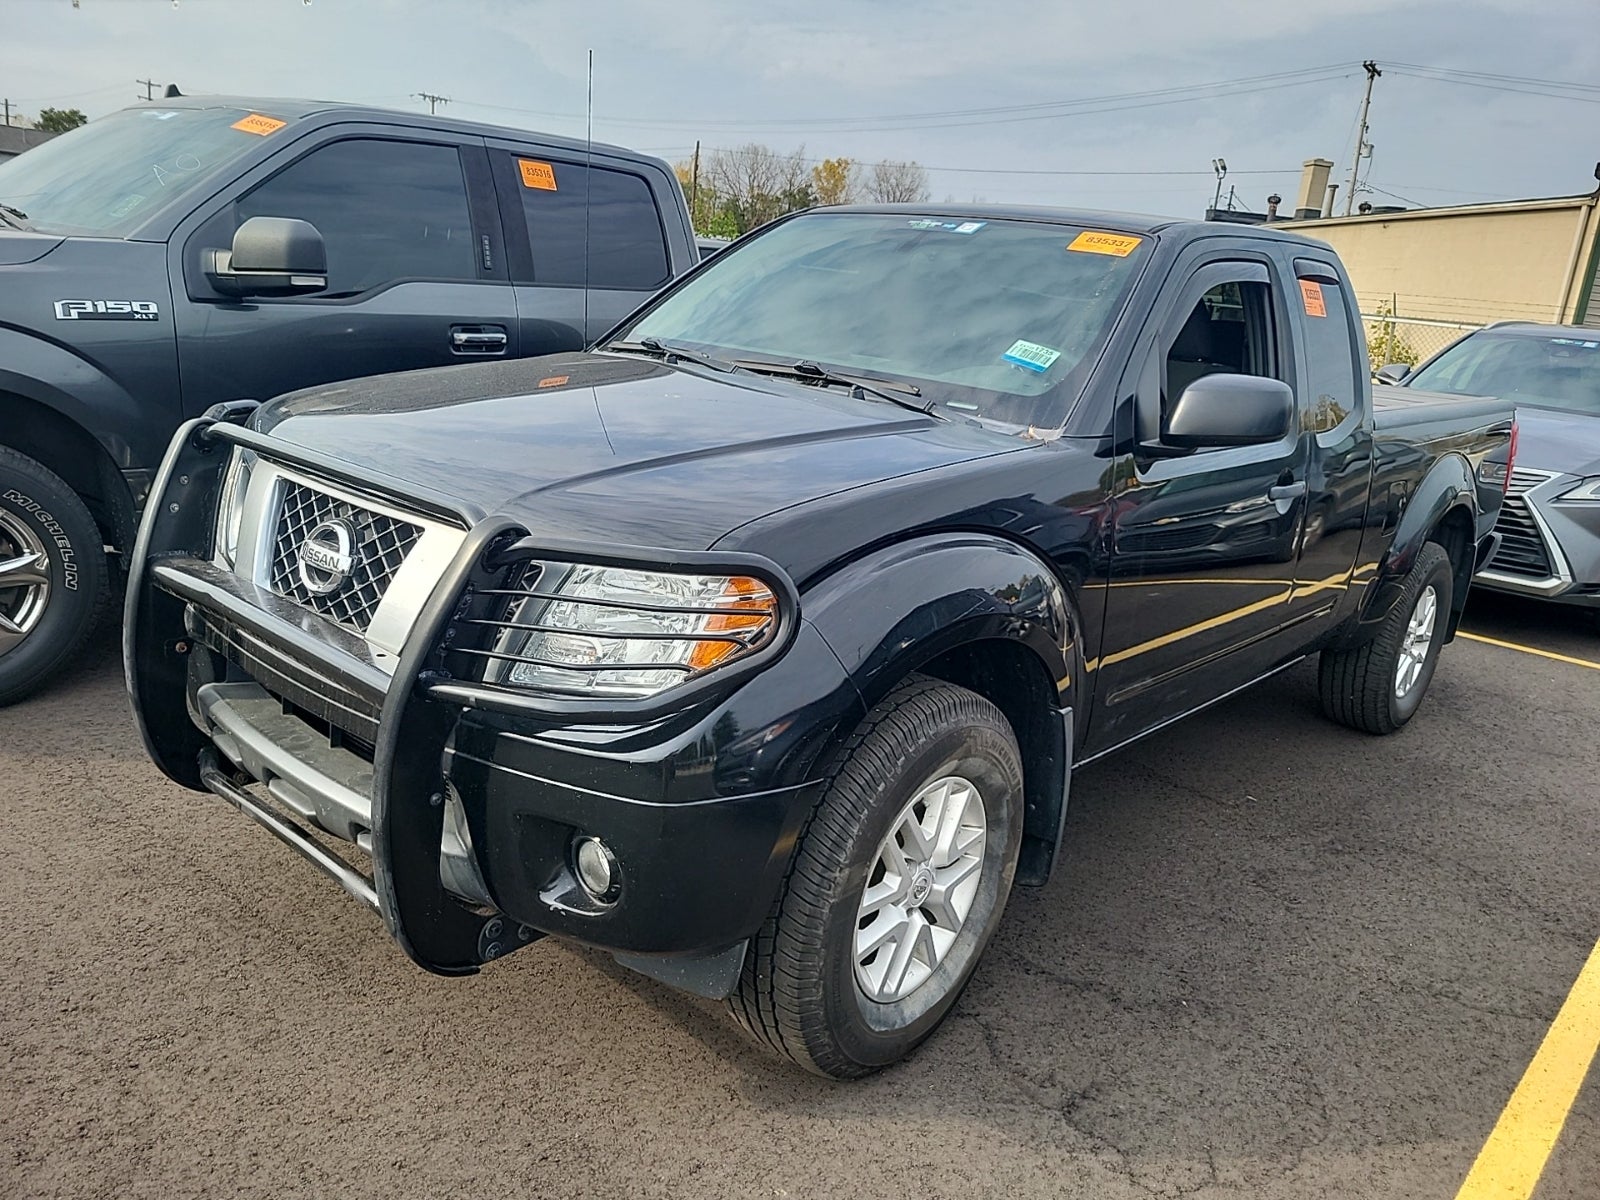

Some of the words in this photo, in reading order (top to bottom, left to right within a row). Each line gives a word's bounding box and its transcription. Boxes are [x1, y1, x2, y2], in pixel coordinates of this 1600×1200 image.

[526, 166, 552, 179] 835316
[1086, 236, 1134, 248] 835337
[3, 489, 78, 590] MICHELIN
[301, 541, 340, 569] NISSAN
